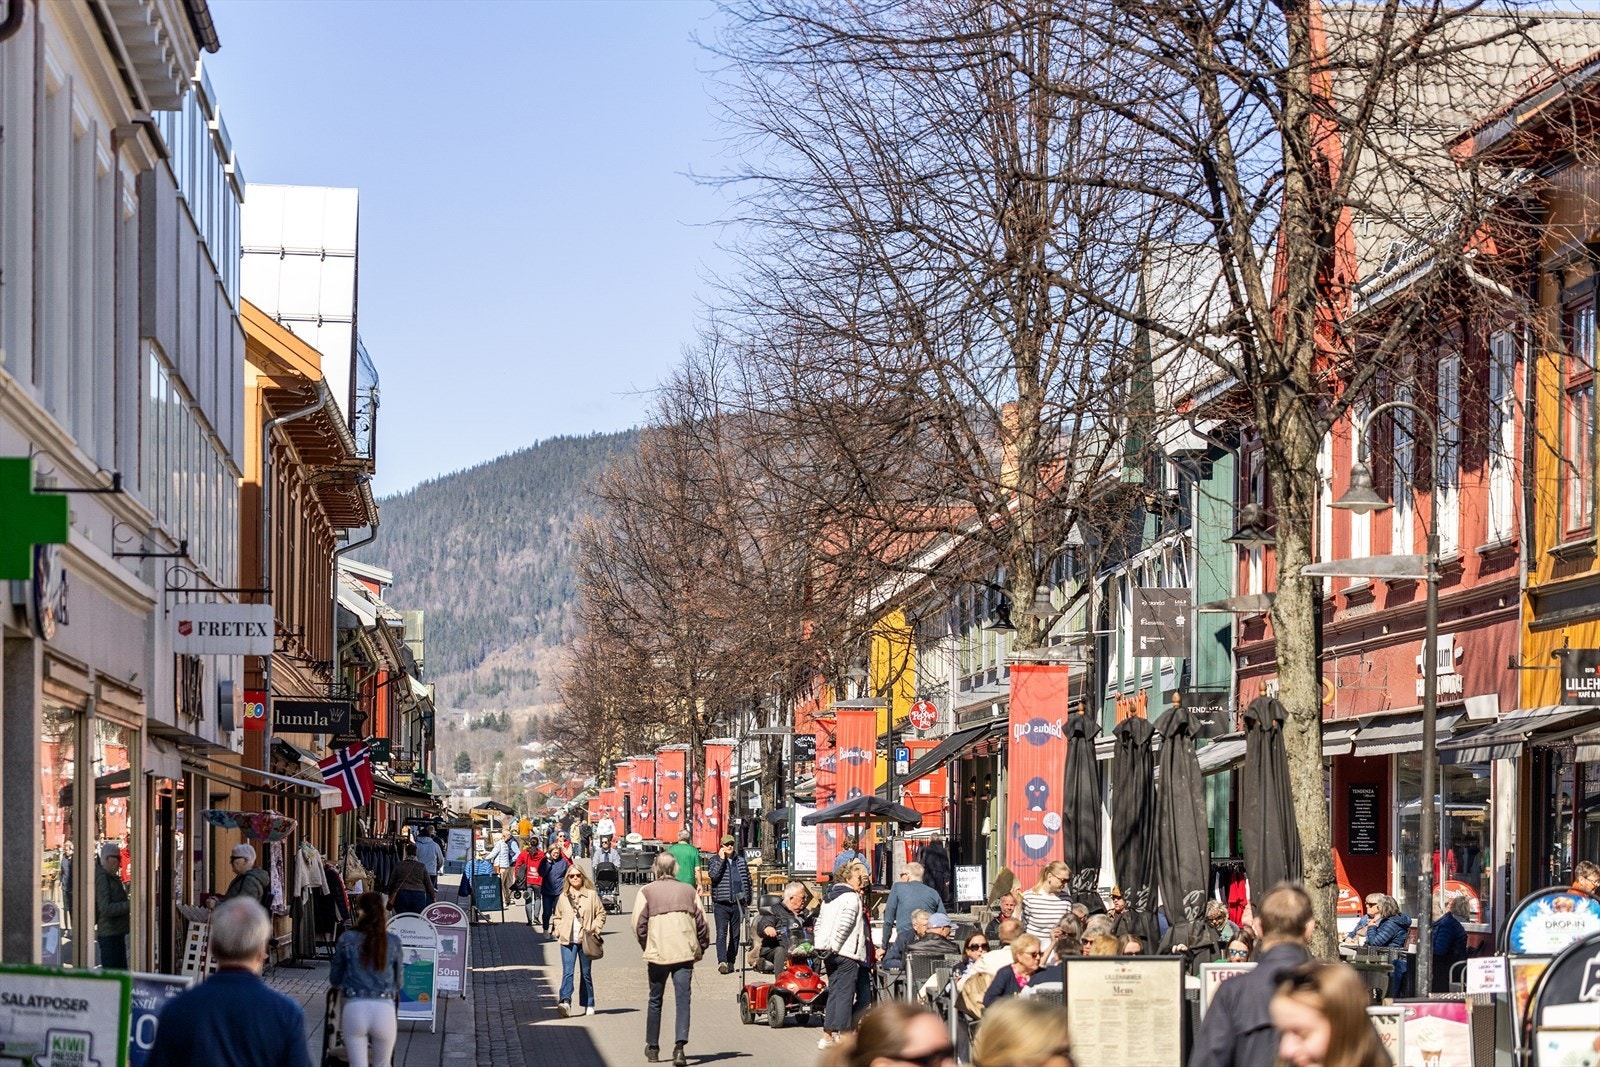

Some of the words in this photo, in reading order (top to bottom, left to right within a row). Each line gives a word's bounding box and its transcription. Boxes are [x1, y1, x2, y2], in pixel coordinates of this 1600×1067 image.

[198, 621, 268, 637] FRETEX
[1565, 677, 1600, 691] LILLEH
[243, 702, 265, 718] GO
[275, 709, 329, 726] lunula
[840, 746, 859, 761] Baldus
[860, 749, 873, 764] Cup
[899, 750, 906, 760] P
[745, 850, 762, 858] WO
[1545, 921, 1586, 929] DROP-IN
[438, 967, 459, 976] 50m
[1, 992, 89, 1012] SALATPOSER
[132, 996, 157, 1010] sstil
[52, 1035, 86, 1052] KIWI
[51, 1050, 84, 1062] PRESSER
